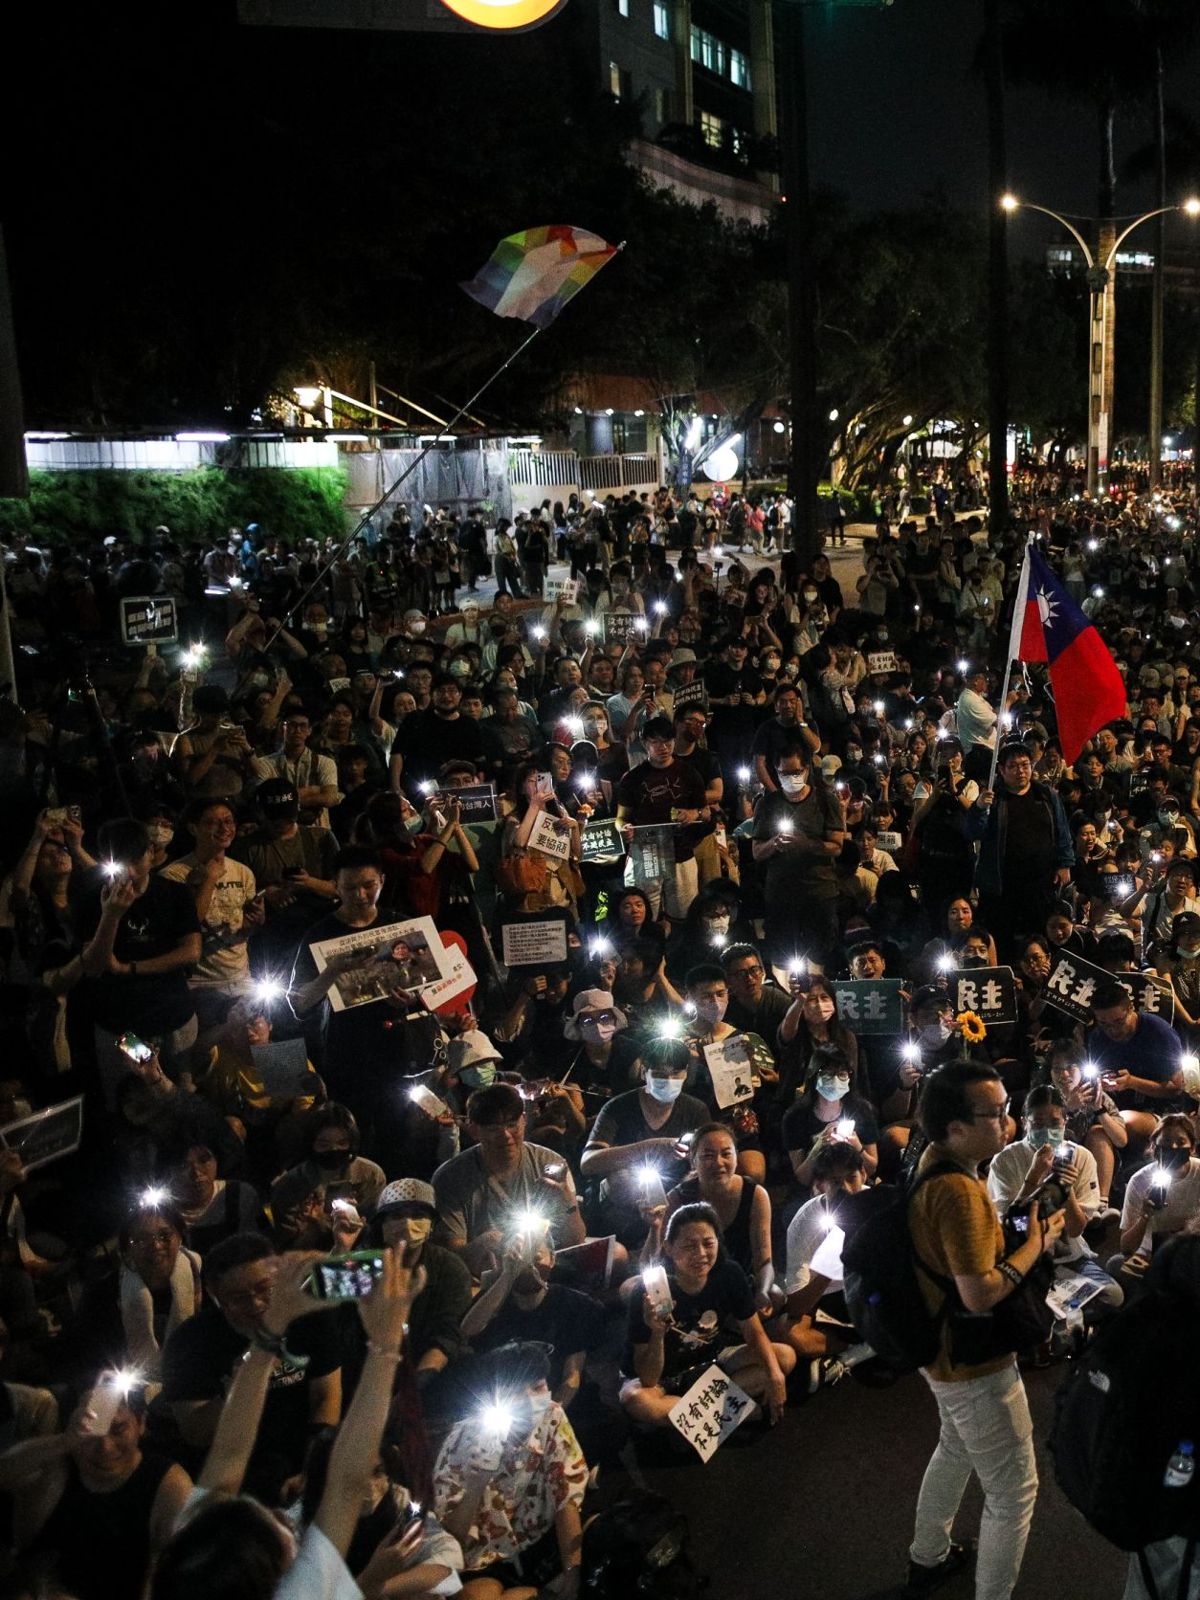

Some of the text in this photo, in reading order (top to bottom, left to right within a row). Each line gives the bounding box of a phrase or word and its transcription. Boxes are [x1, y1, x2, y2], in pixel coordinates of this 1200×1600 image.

[536, 832, 568, 855] 要協商
[957, 977, 1003, 1012] 民主
[1047, 959, 1098, 1008] 民主
[835, 989, 888, 1021] 民主
[676, 1379, 729, 1435] 沒有討論
[694, 1396, 748, 1450] 不是民主
